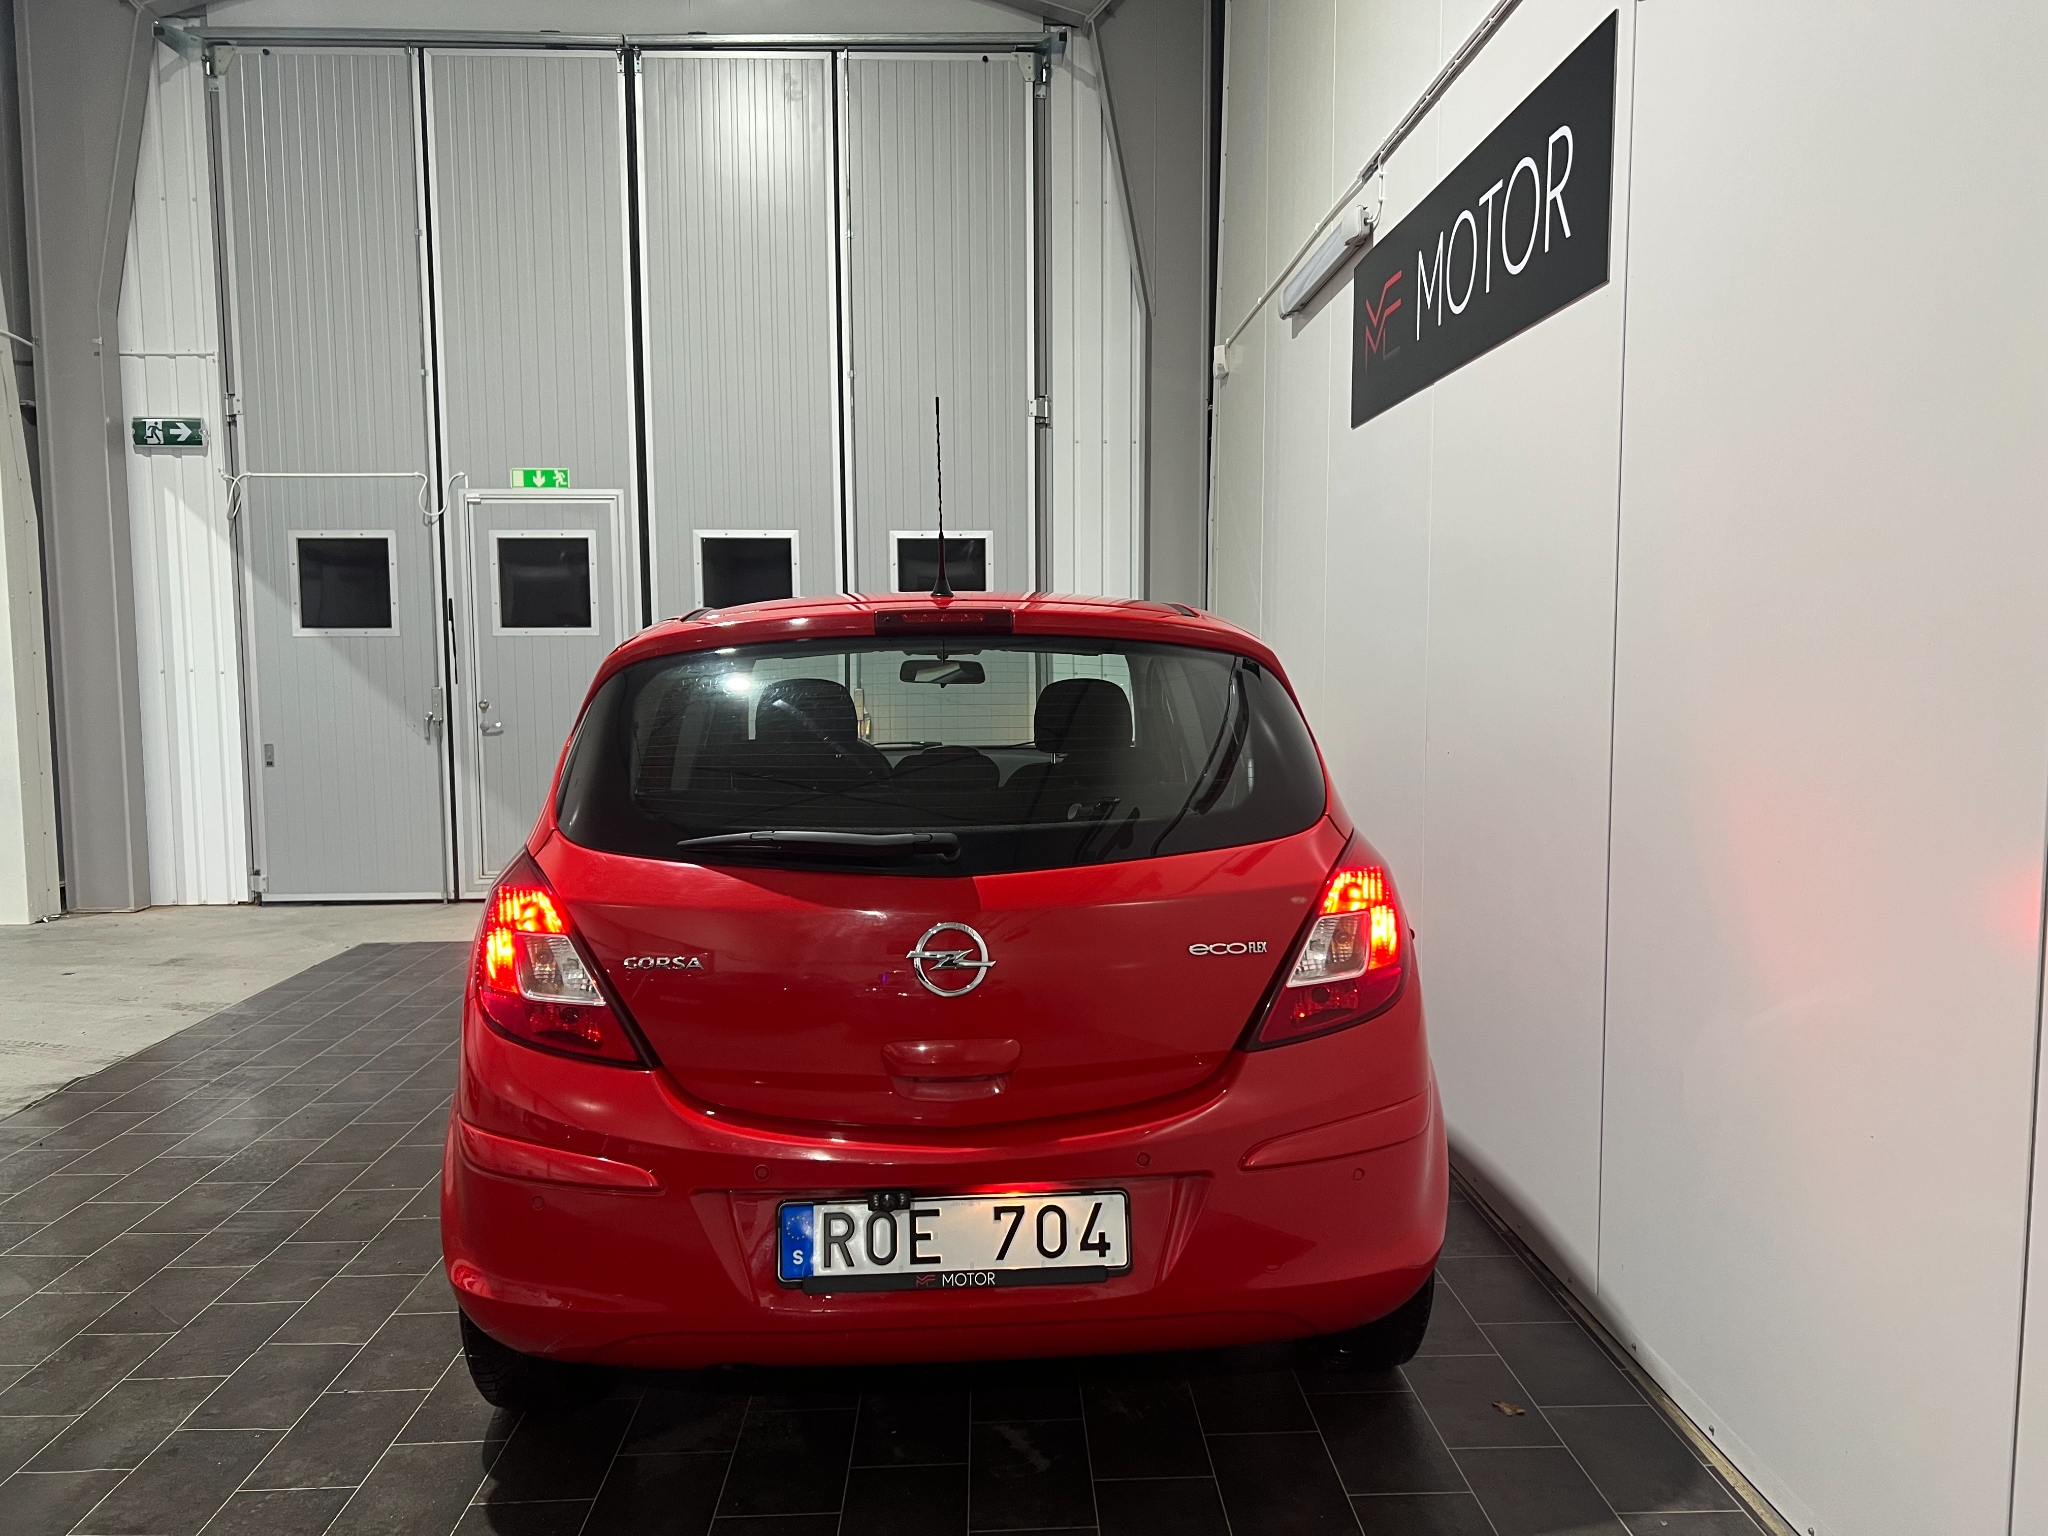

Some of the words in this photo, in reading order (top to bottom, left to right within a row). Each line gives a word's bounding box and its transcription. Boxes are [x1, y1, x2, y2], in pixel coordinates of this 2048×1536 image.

[1415, 125, 1574, 342] MOTOR
[623, 956, 704, 970] CORSA
[823, 1208, 942, 1268] ROE
[993, 1202, 1111, 1261] 704
[792, 1249, 804, 1265] S
[942, 1271, 996, 1287] MOTOR
